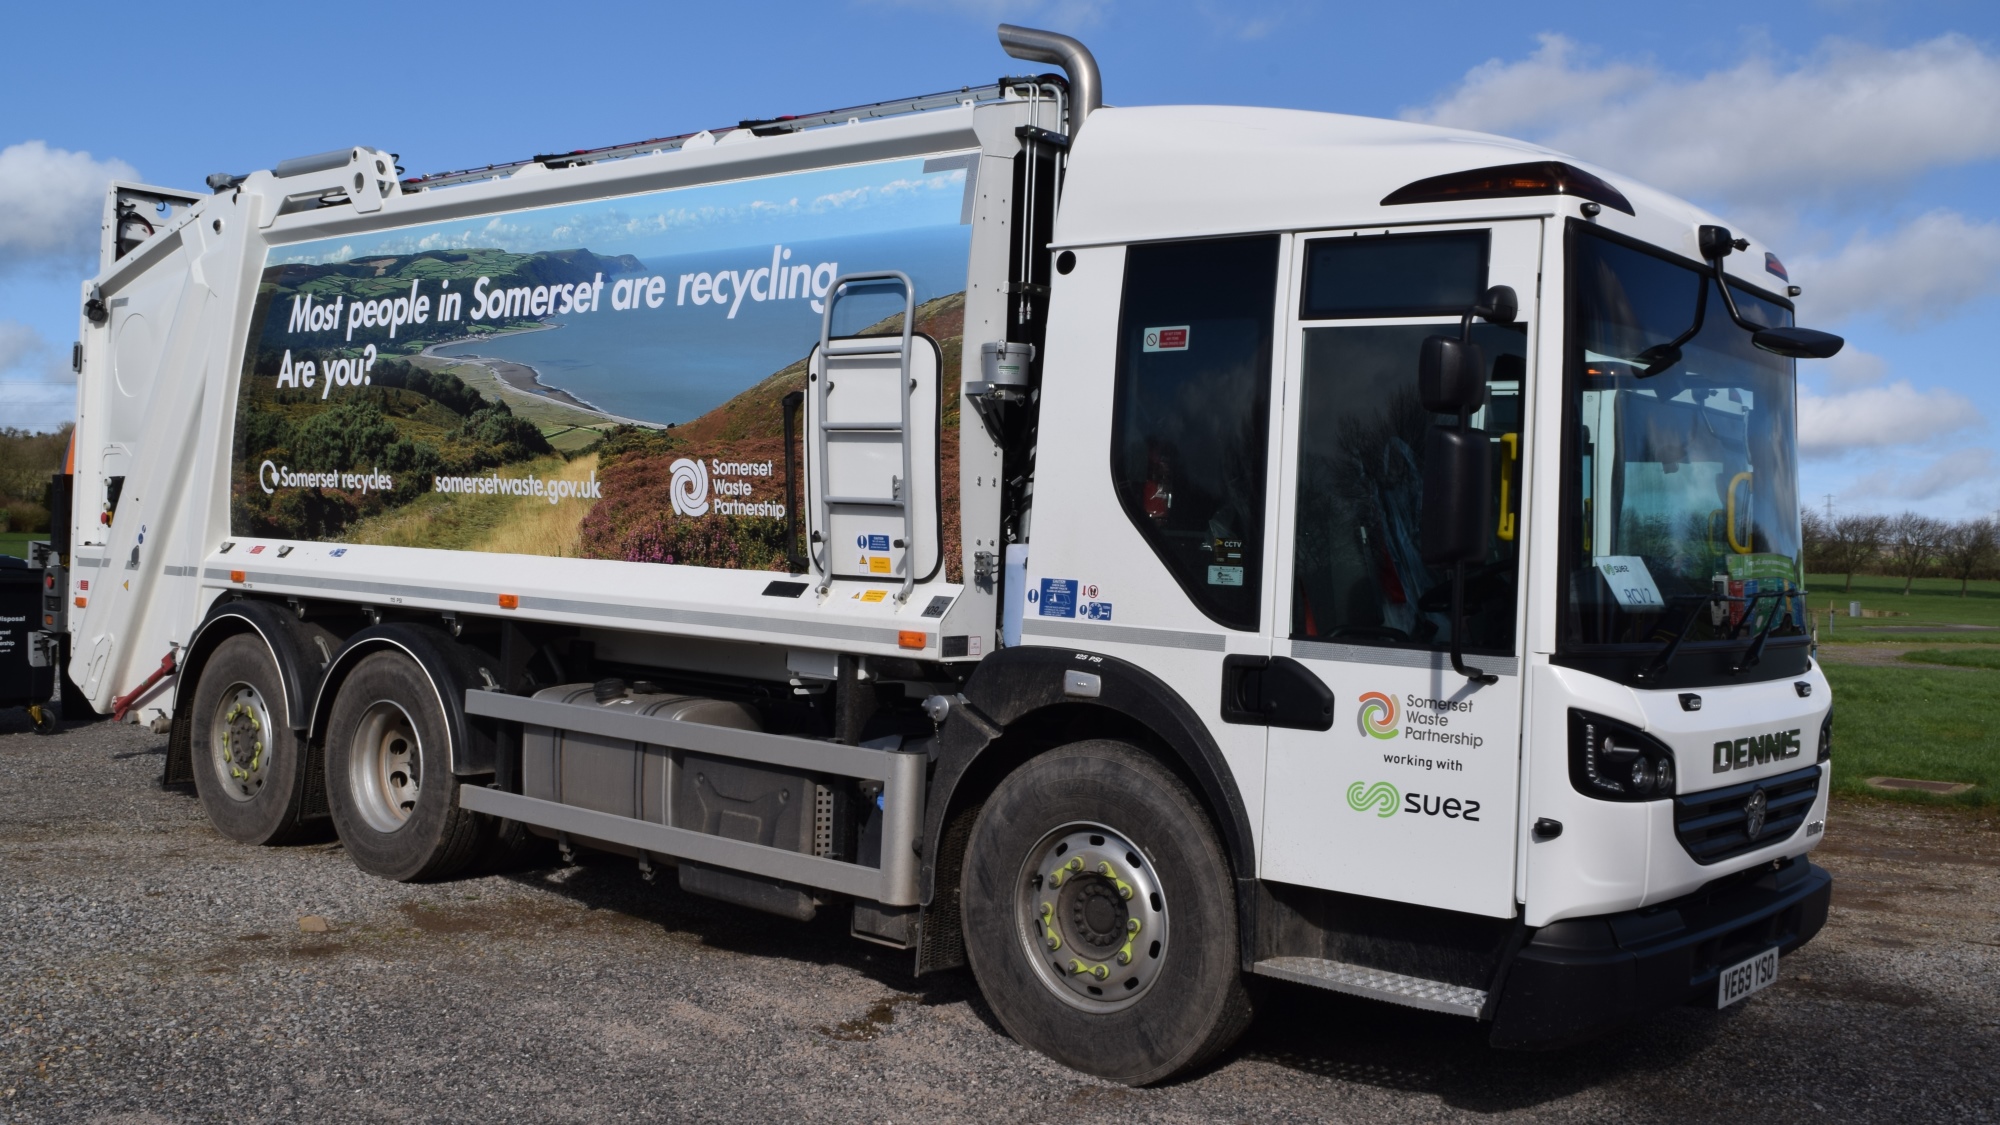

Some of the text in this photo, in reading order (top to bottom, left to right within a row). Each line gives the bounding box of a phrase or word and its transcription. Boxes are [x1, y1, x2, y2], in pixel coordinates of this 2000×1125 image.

[288, 293, 343, 334] Most
[346, 278, 430, 342] people
[437, 279, 462, 322] in
[470, 271, 604, 321] Somerset
[611, 275, 666, 312] are
[277, 343, 377, 400] Are you?
[712, 459, 773, 477] Somerset
[281, 465, 393, 495] Somerset recycles
[435, 470, 602, 505] somersetwaste.gov.uk
[713, 479, 752, 496] Waste
[714, 499, 786, 521] Partnership
[1088, 655, 1103, 663] PSI
[1406, 693, 1473, 713] Somerset
[1406, 710, 1449, 727] Waste
[1405, 726, 1484, 749] Partnership
[1383, 754, 1463, 772] working with
[1712, 728, 1801, 775] DENNIS
[1404, 792, 1481, 822] suez
[1723, 963, 1751, 1002] VE69
